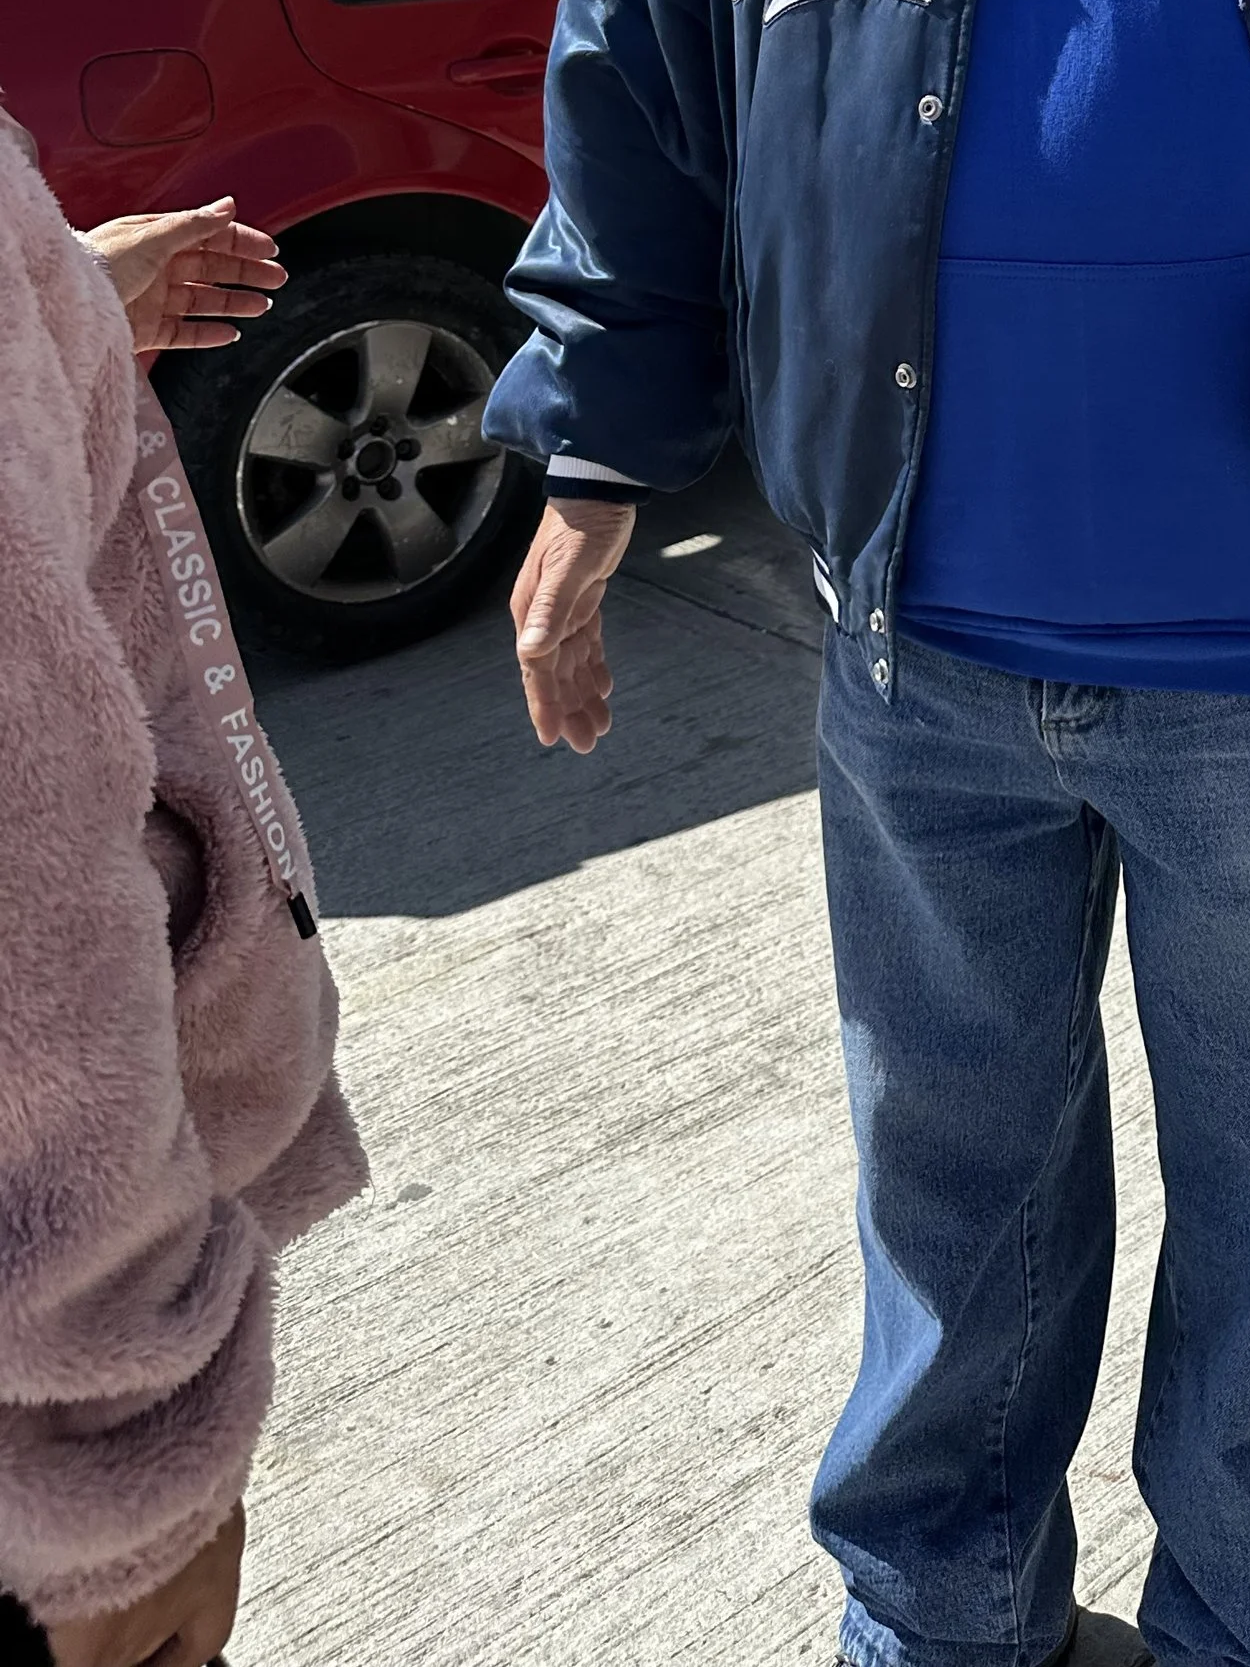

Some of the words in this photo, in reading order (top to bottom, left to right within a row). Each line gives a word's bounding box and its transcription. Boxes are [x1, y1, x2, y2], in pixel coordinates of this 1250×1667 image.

[147, 476, 222, 646] CLASSIC
[204, 664, 235, 695] &
[221, 707, 297, 880] FASHION
